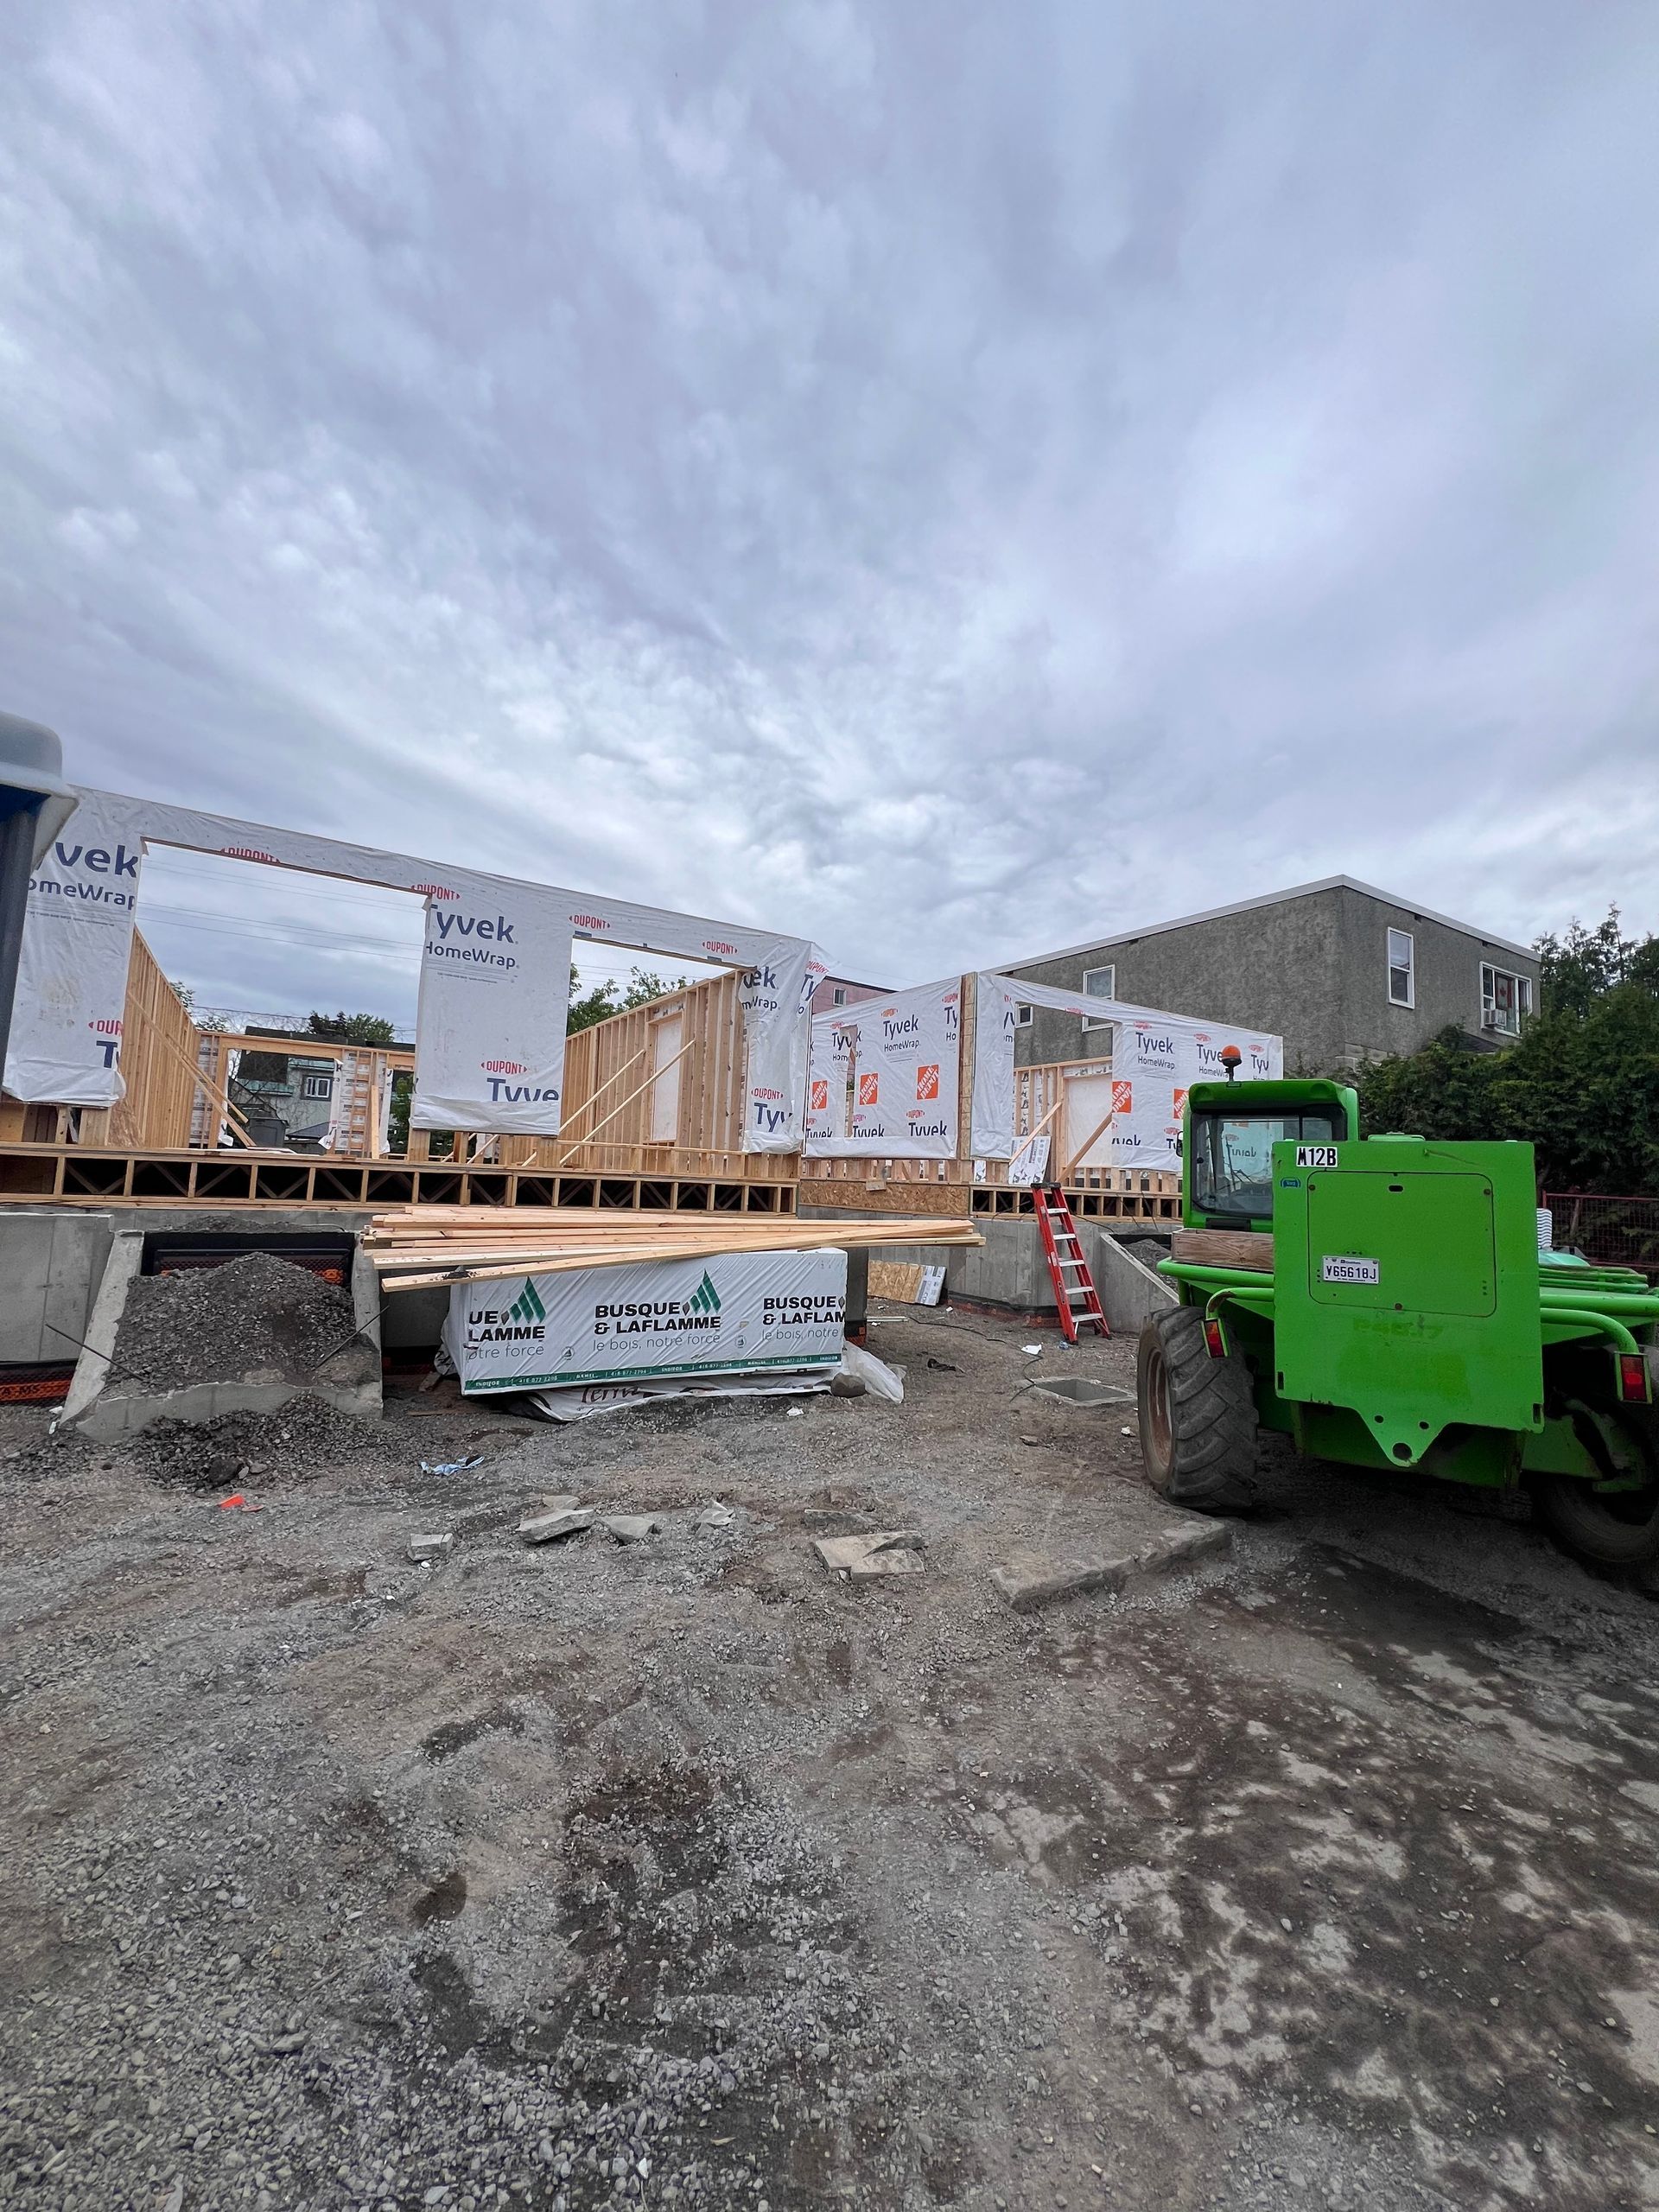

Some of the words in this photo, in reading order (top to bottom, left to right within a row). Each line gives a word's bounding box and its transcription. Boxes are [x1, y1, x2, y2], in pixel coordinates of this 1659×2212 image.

[574, 914, 607, 929] DUPONT
[706, 940, 734, 954] DUPONT
[883, 1014, 918, 1039] Tyvek
[885, 1039, 919, 1052] HomeWrap
[1135, 1032, 1174, 1054] Tyvek
[486, 1060, 523, 1074] DUPONT
[1138, 1056, 1175, 1069] HomeWrap
[917, 1065, 934, 1092] HOME
[920, 1069, 939, 1099] DEPOT
[754, 1088, 779, 1100] DUPONT
[1298, 1147, 1337, 1166] M12B
[595, 1302, 681, 1318] BUSQUE
[764, 1296, 836, 1310] BUSQUE
[469, 1310, 499, 1325] UE
[762, 1313, 776, 1325] &
[594, 1323, 610, 1335] &
[616, 1317, 721, 1334] LAFLAMME
[468, 1326, 545, 1342] LAMME
[762, 1330, 772, 1341] le
[776, 1329, 804, 1340] bois,
[807, 1328, 839, 1338] notre
[593, 1339, 605, 1351] le
[610, 1338, 642, 1350] bois,
[647, 1336, 683, 1348] notre
[687, 1333, 721, 1344] force
[505, 1344, 544, 1357] force
